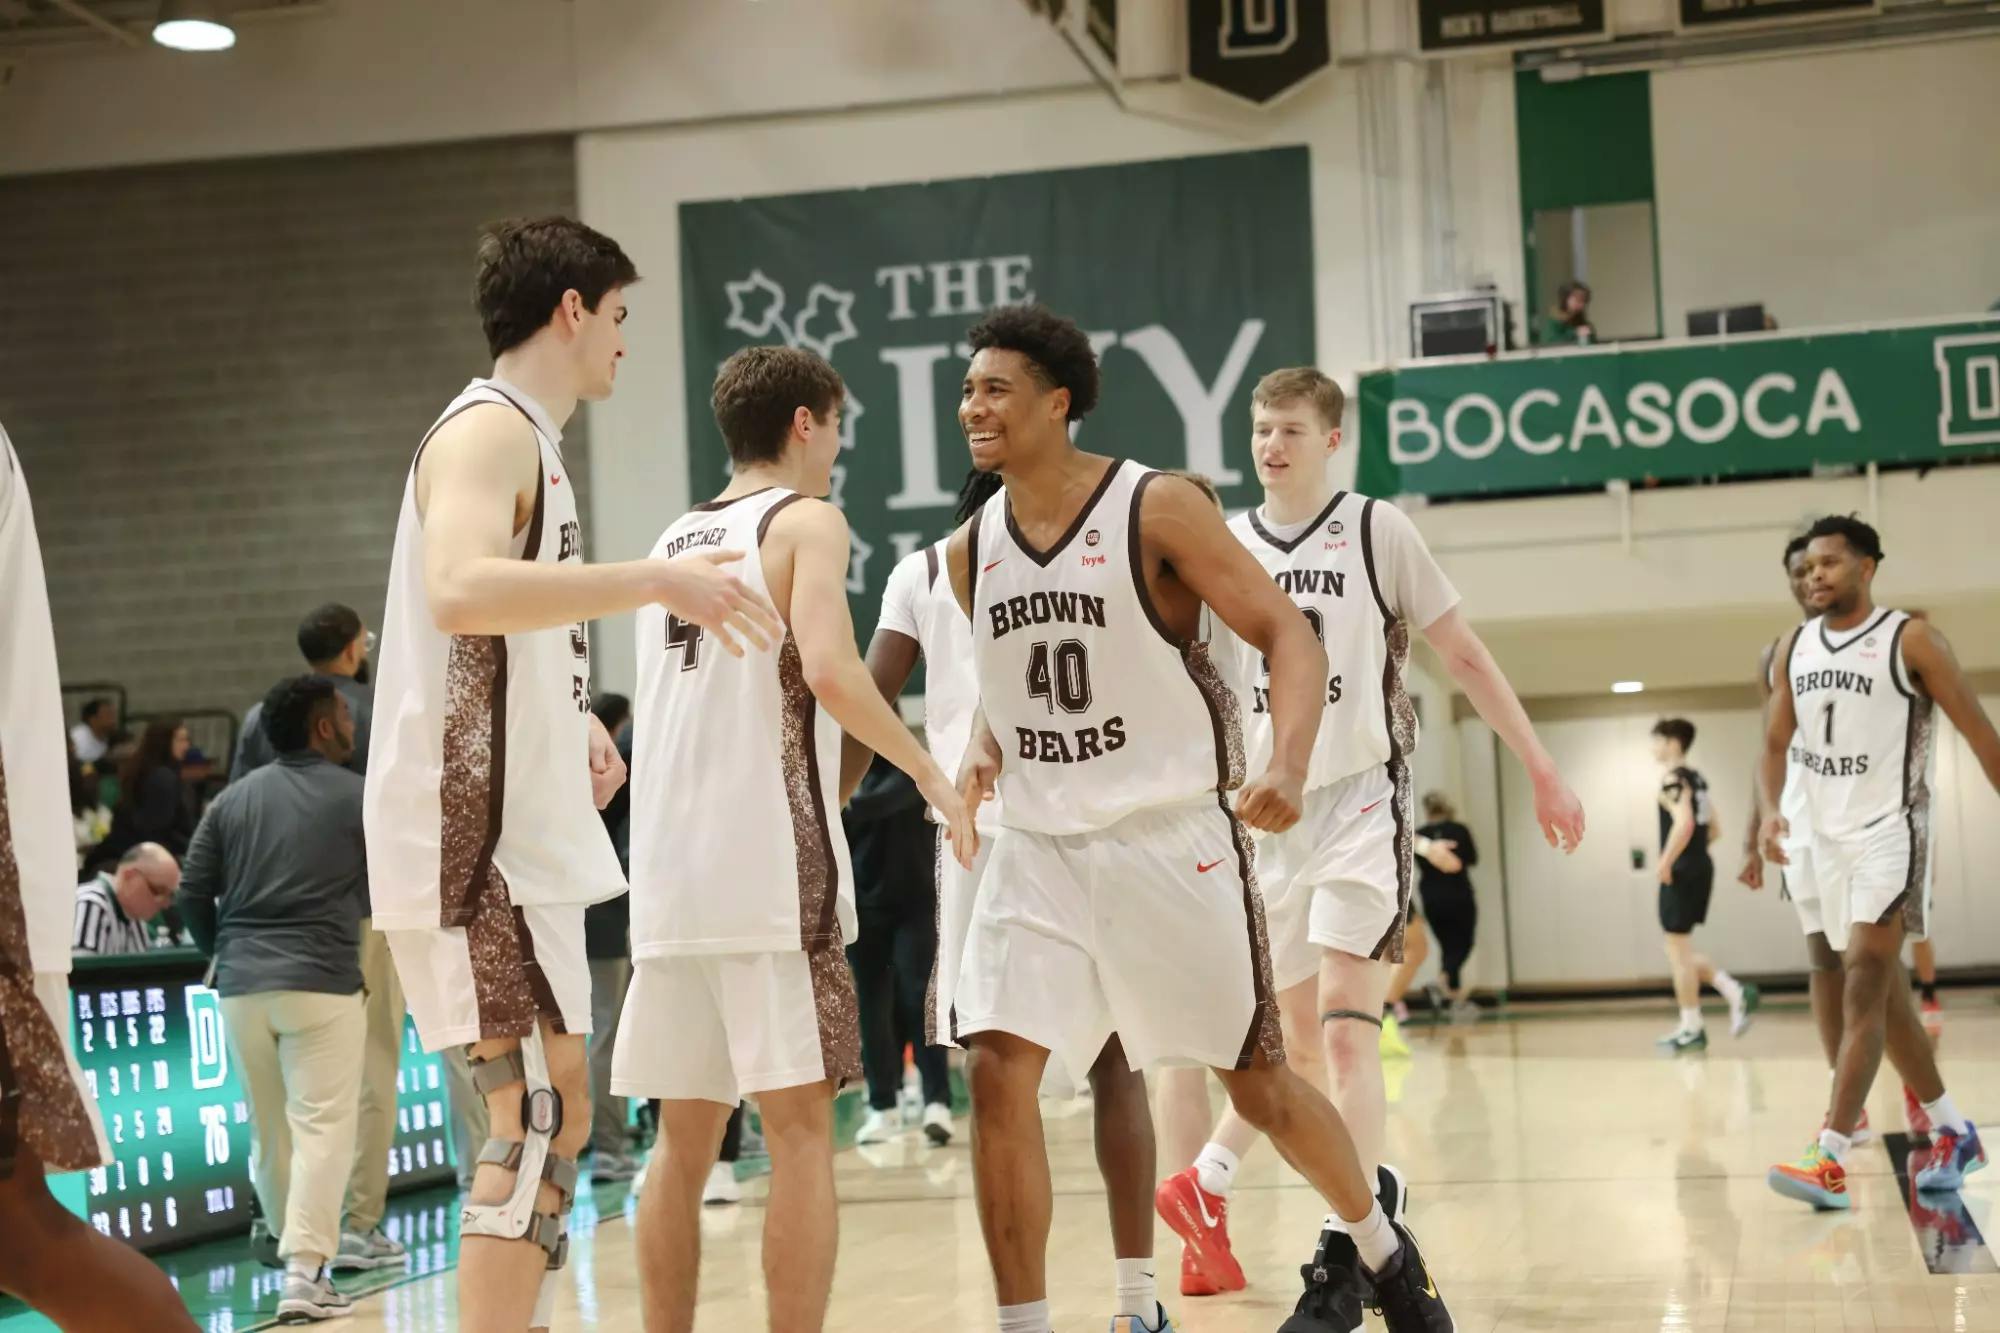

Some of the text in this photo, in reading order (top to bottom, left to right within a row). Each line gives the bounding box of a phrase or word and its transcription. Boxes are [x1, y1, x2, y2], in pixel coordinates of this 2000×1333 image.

[876, 256, 1036, 320] THE
[879, 318, 1266, 510] IY
[1387, 367, 1861, 465] BOCASOCA
[666, 527, 727, 560] DREZNER
[1081, 555, 1097, 568] Ivy
[1275, 569, 1345, 598] OWN
[988, 591, 1107, 640] BROWN
[1025, 638, 1093, 715] 40
[1796, 669, 1874, 697] BROWN
[1015, 716, 1127, 764] BEARS
[1822, 700, 1836, 746] 1
[82, 1021, 94, 1053] 2
